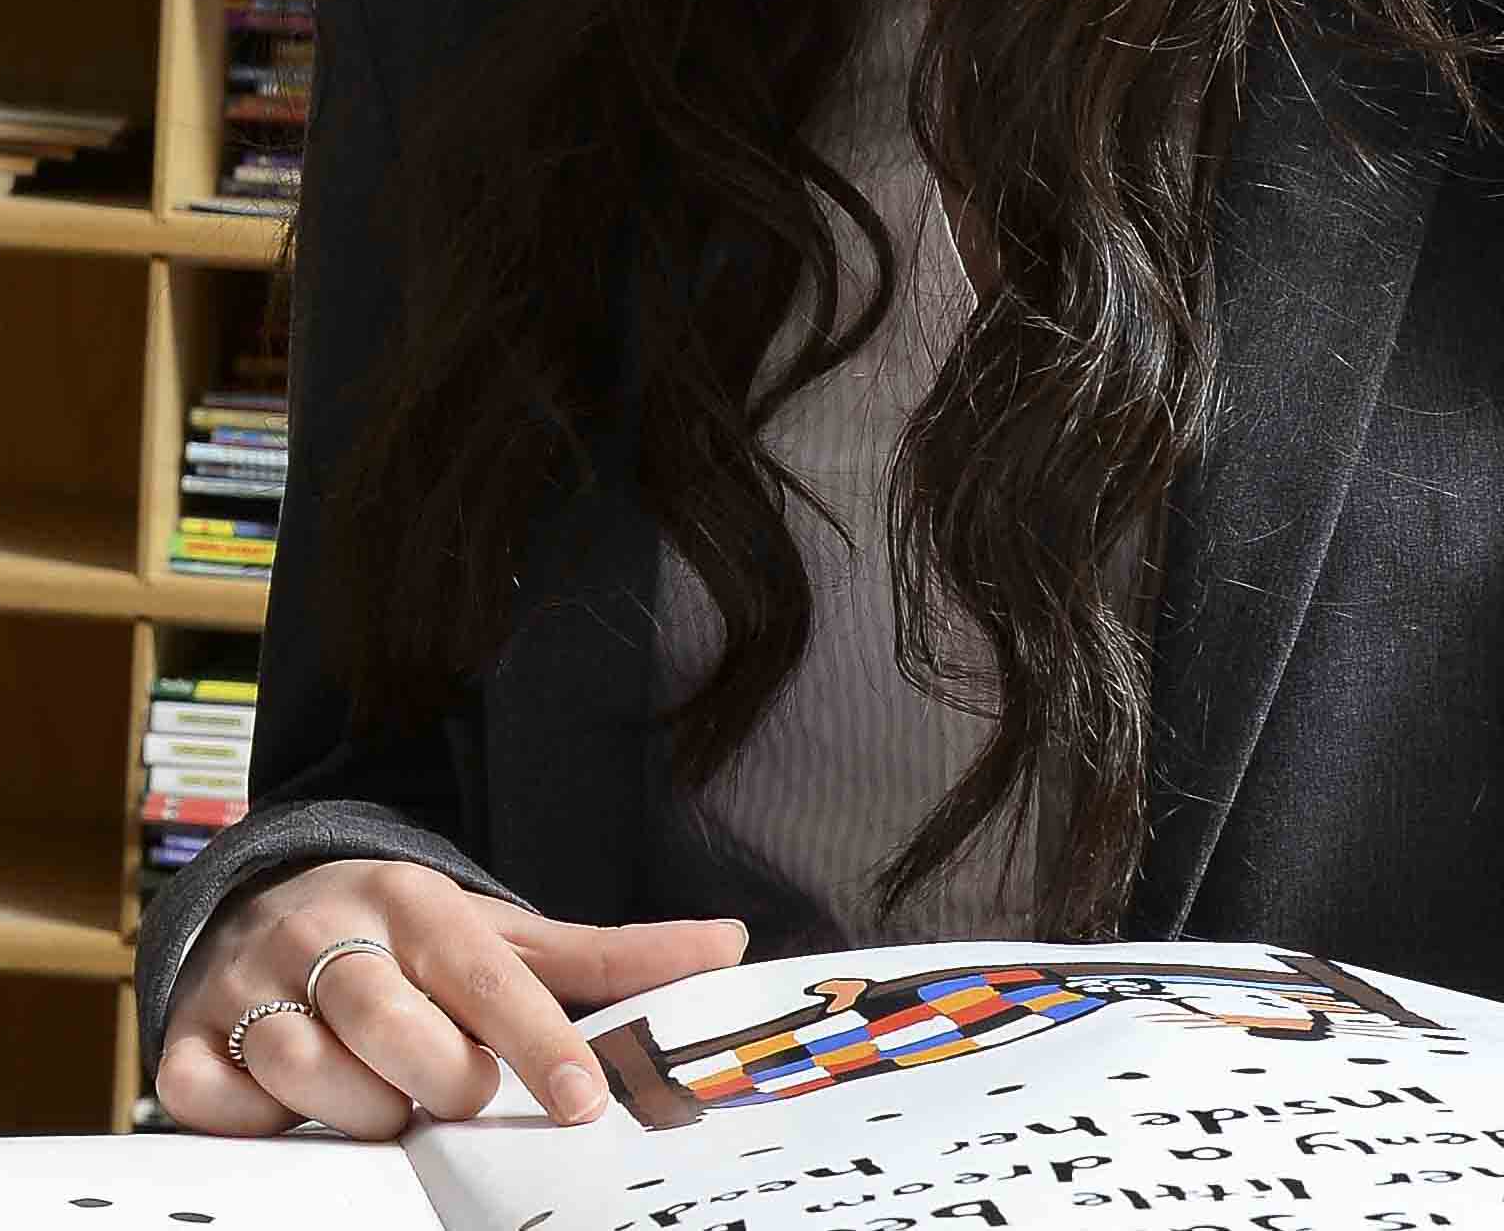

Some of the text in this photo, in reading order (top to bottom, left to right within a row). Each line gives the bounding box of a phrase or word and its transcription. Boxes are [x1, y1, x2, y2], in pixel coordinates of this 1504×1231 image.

[1132, 1085, 1454, 1135] inside
[941, 1115, 1108, 1155] her
[1167, 1145, 1234, 1162] a
[804, 1155, 1113, 1213] dream
[1071, 1177, 1312, 1211] little
[830, 1199, 1008, 1231] be
